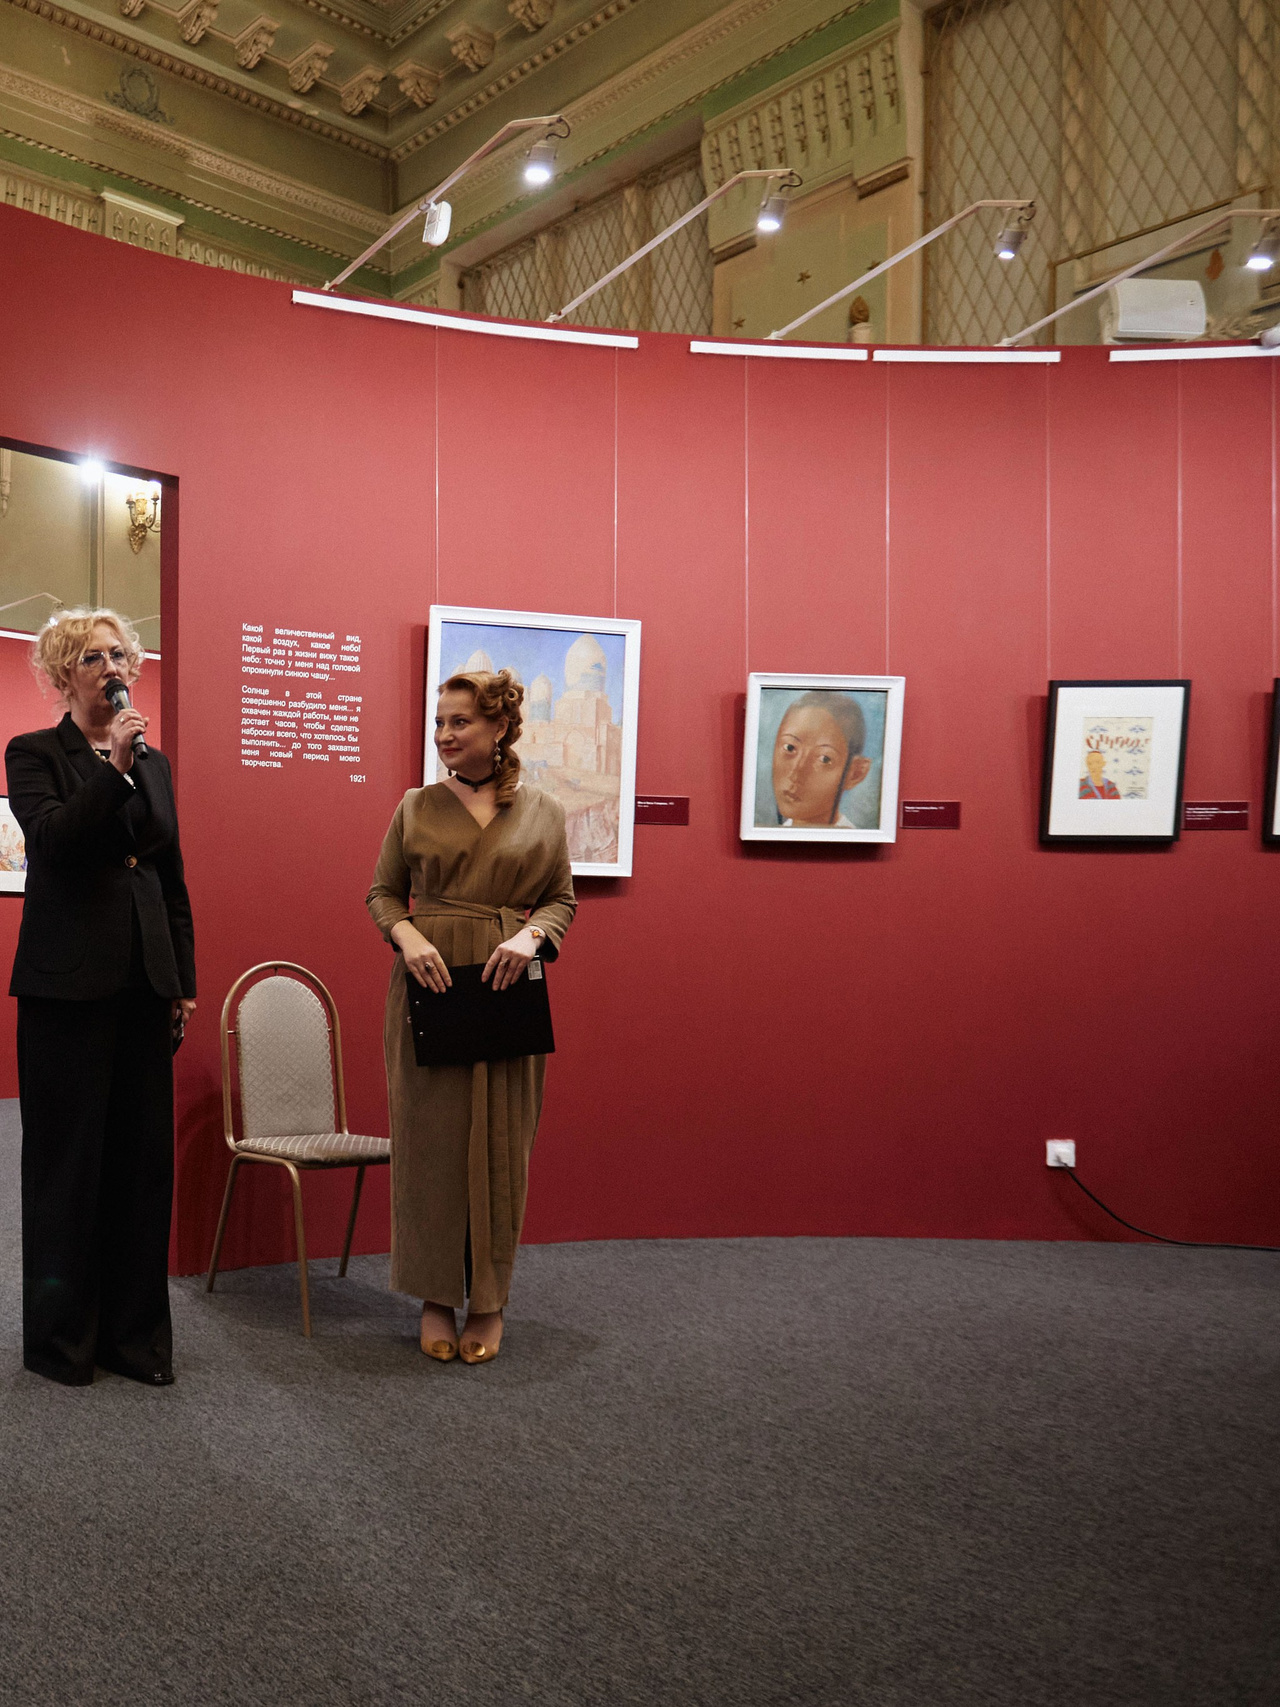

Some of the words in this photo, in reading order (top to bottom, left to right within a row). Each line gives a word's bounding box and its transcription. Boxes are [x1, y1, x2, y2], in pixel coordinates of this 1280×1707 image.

[242, 623, 263, 632] Какой
[275, 628, 334, 639] величественный
[242, 635, 262, 643] какой
[341, 644, 360, 652] небо!
[242, 644, 270, 654] Первый
[273, 648, 285, 656] раз
[295, 650, 317, 658] жизни
[320, 653, 337, 661] вижу
[340, 654, 359, 662] такое
[242, 666, 283, 677] опрокинули
[285, 670, 309, 678] синюю
[265, 658, 285, 666] точно
[288, 660, 292, 668] у
[332, 663, 360, 672] головой
[242, 685, 269, 695] Солнце
[338, 694, 362, 702] стране
[242, 697, 286, 706] совершенно
[289, 701, 326, 710] разбудило
[273, 710, 300, 718] жаждой
[241, 718, 269, 726] достает
[304, 722, 325, 730] чтобы
[331, 724, 359, 732] сделать
[242, 728, 274, 737] наброски
[348, 734, 358, 742] бы
[328, 744, 359, 752] захватил
[303, 753, 329, 761] период
